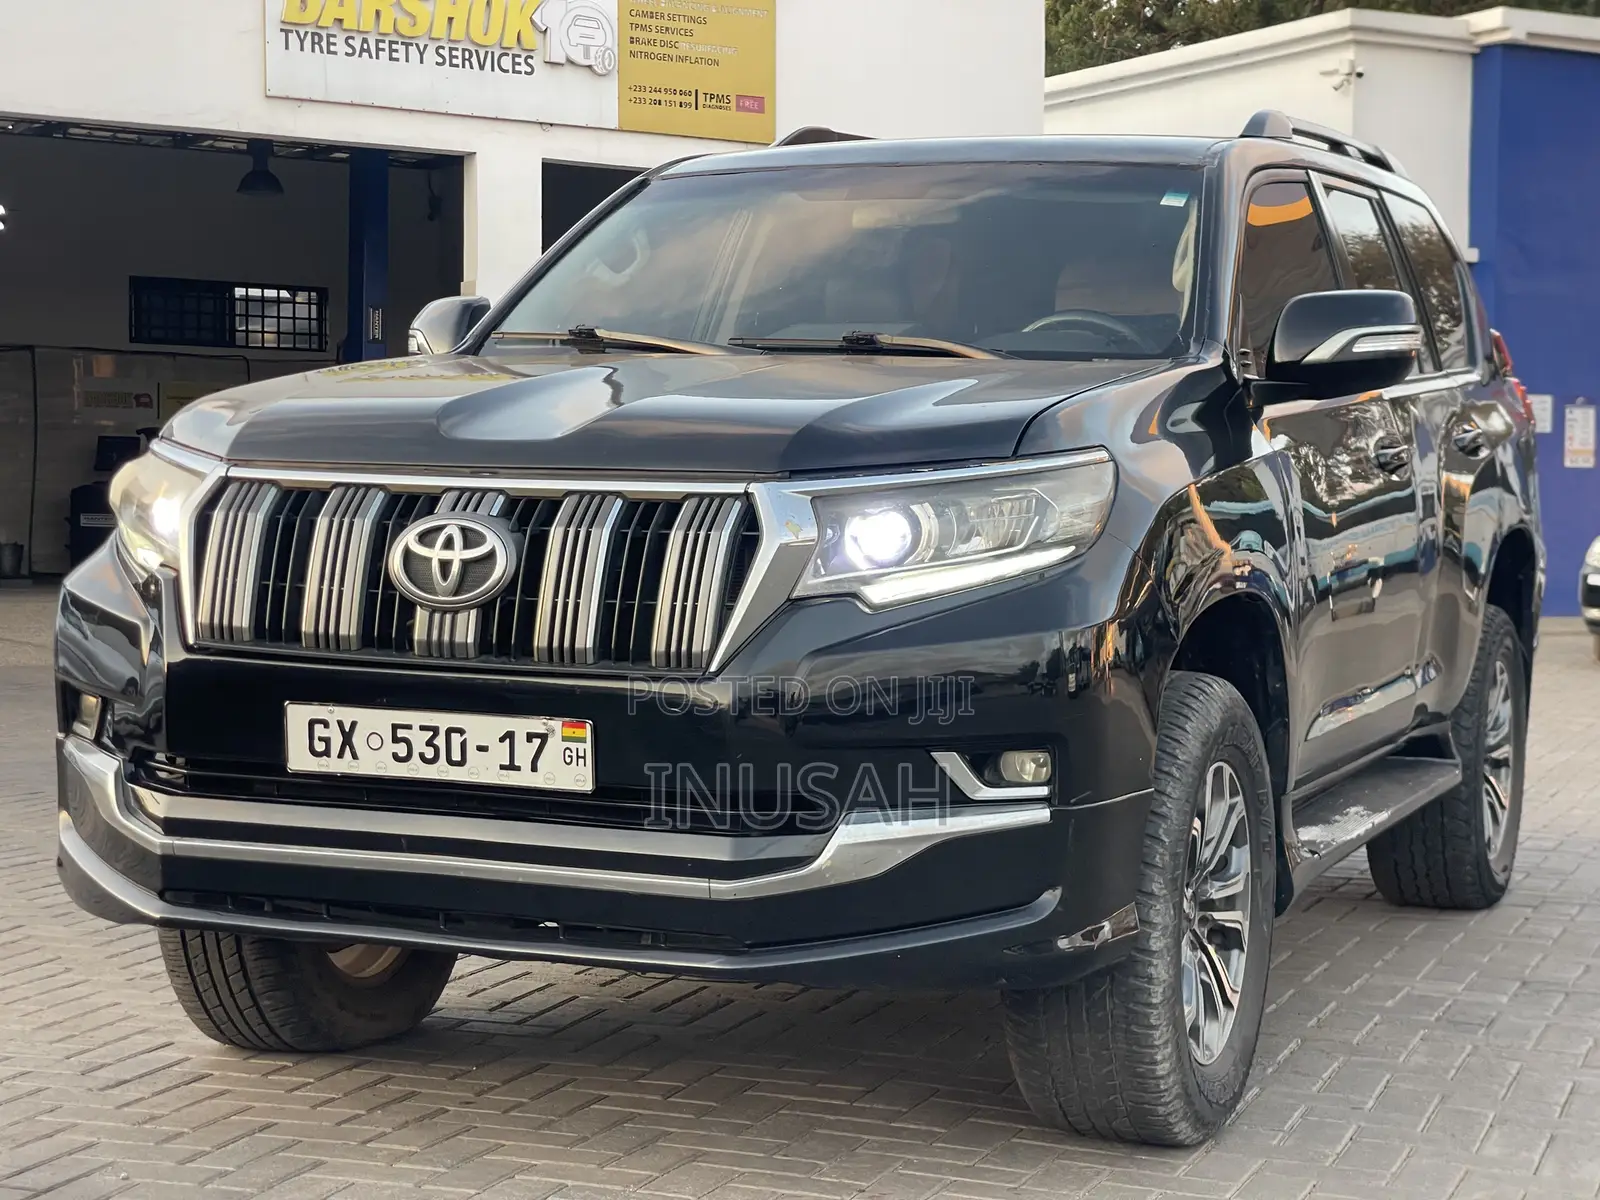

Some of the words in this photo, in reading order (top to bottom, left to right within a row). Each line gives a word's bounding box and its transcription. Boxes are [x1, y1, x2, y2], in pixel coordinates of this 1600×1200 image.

[629, 9, 665, 21] CAMBER
[667, 14, 707, 25] SETTINGS
[629, 22, 653, 33] TPMS
[655, 25, 694, 37] SERVICES
[629, 36, 658, 47] BRAKE
[660, 39, 679, 49] DISC
[279, 28, 338, 56] TYRE
[344, 35, 429, 65] SAFETY
[435, 45, 536, 76] SERVICES
[629, 50, 674, 63] NITROGEN
[675, 54, 720, 67] INFLATION
[628, 84, 647, 93] +233
[648, 86, 662, 94] 244
[663, 87, 678, 96] 950
[628, 96, 647, 105] +233
[664, 99, 677, 107] 151
[702, 92, 731, 105] TPMS
[740, 99, 759, 110] FREE
[307, 717, 360, 760] GX
[390, 722, 549, 773] 530-17
[563, 746, 587, 768] GH
